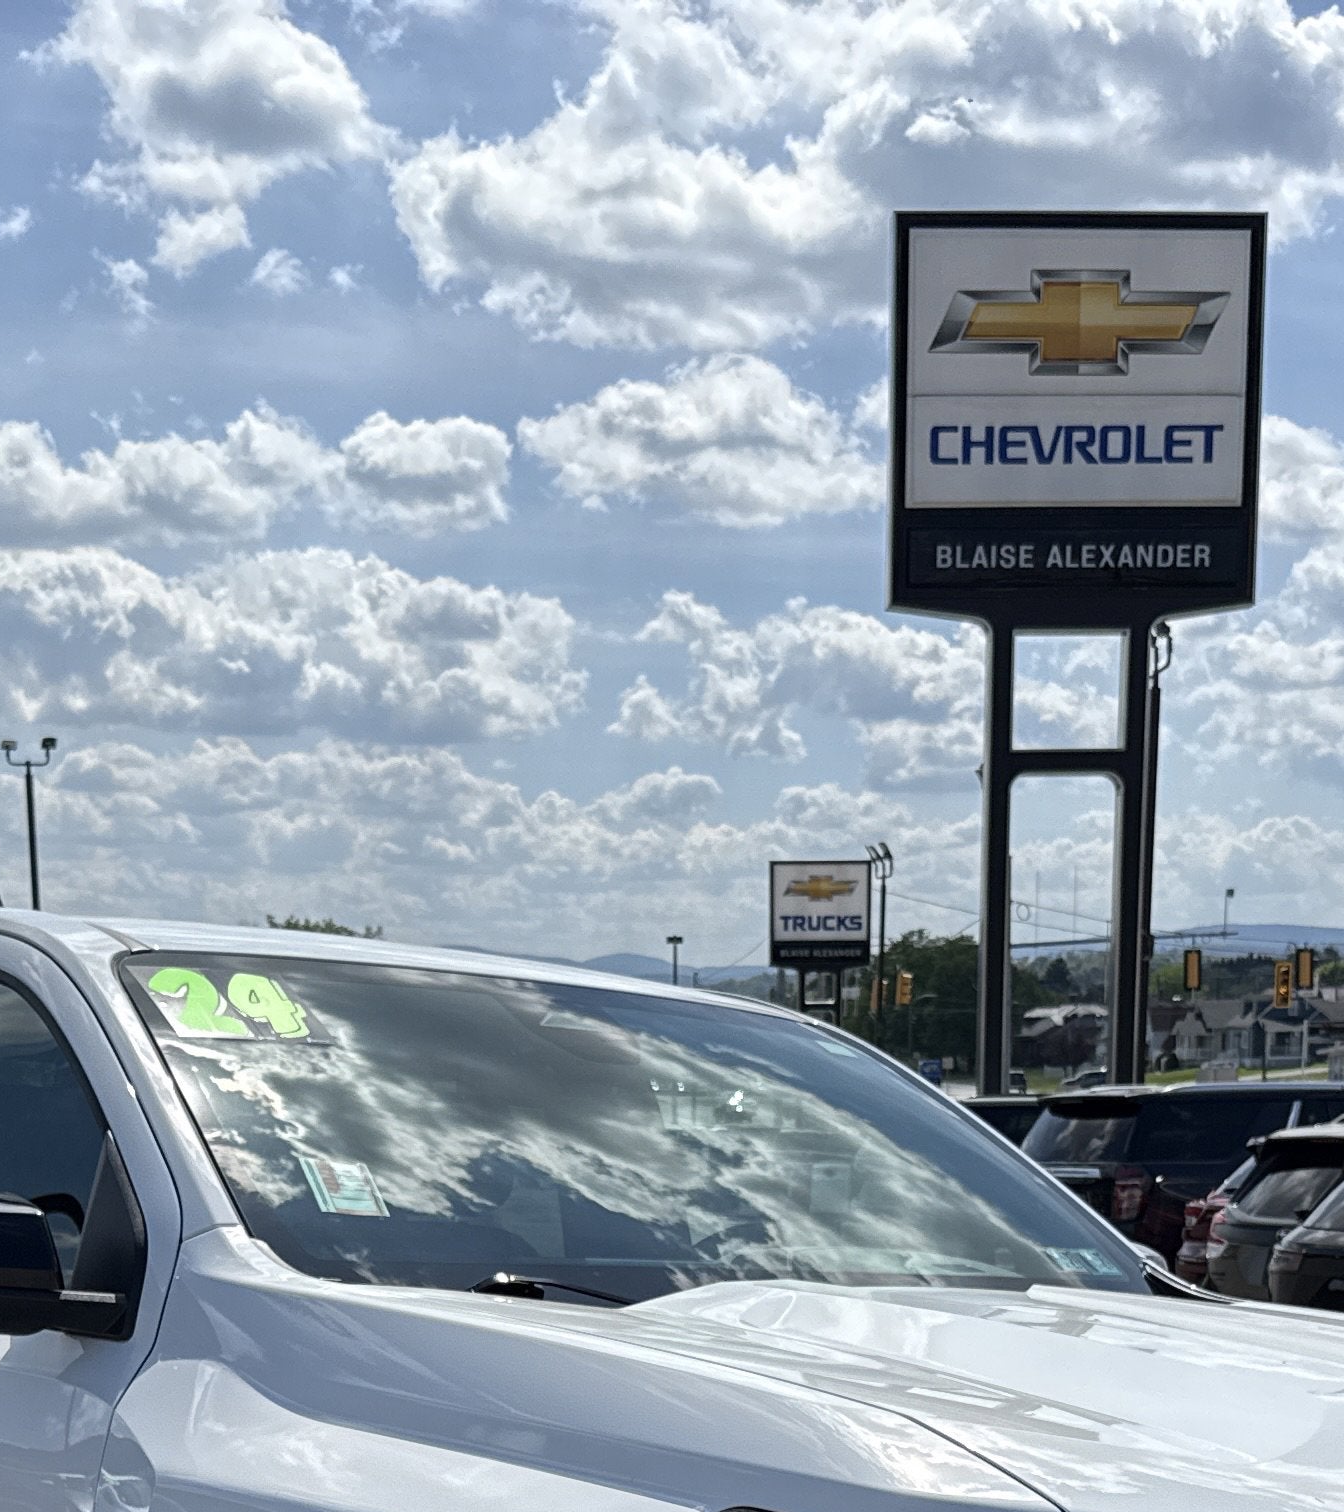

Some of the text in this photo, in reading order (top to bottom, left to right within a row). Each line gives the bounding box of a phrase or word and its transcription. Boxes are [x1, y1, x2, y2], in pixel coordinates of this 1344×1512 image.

[929, 424, 1224, 465] CHEVROLET
[935, 544, 1211, 569] BLAISE ALEXANDER
[780, 915, 863, 931] TRUCKS
[148, 967, 311, 1038] 24
